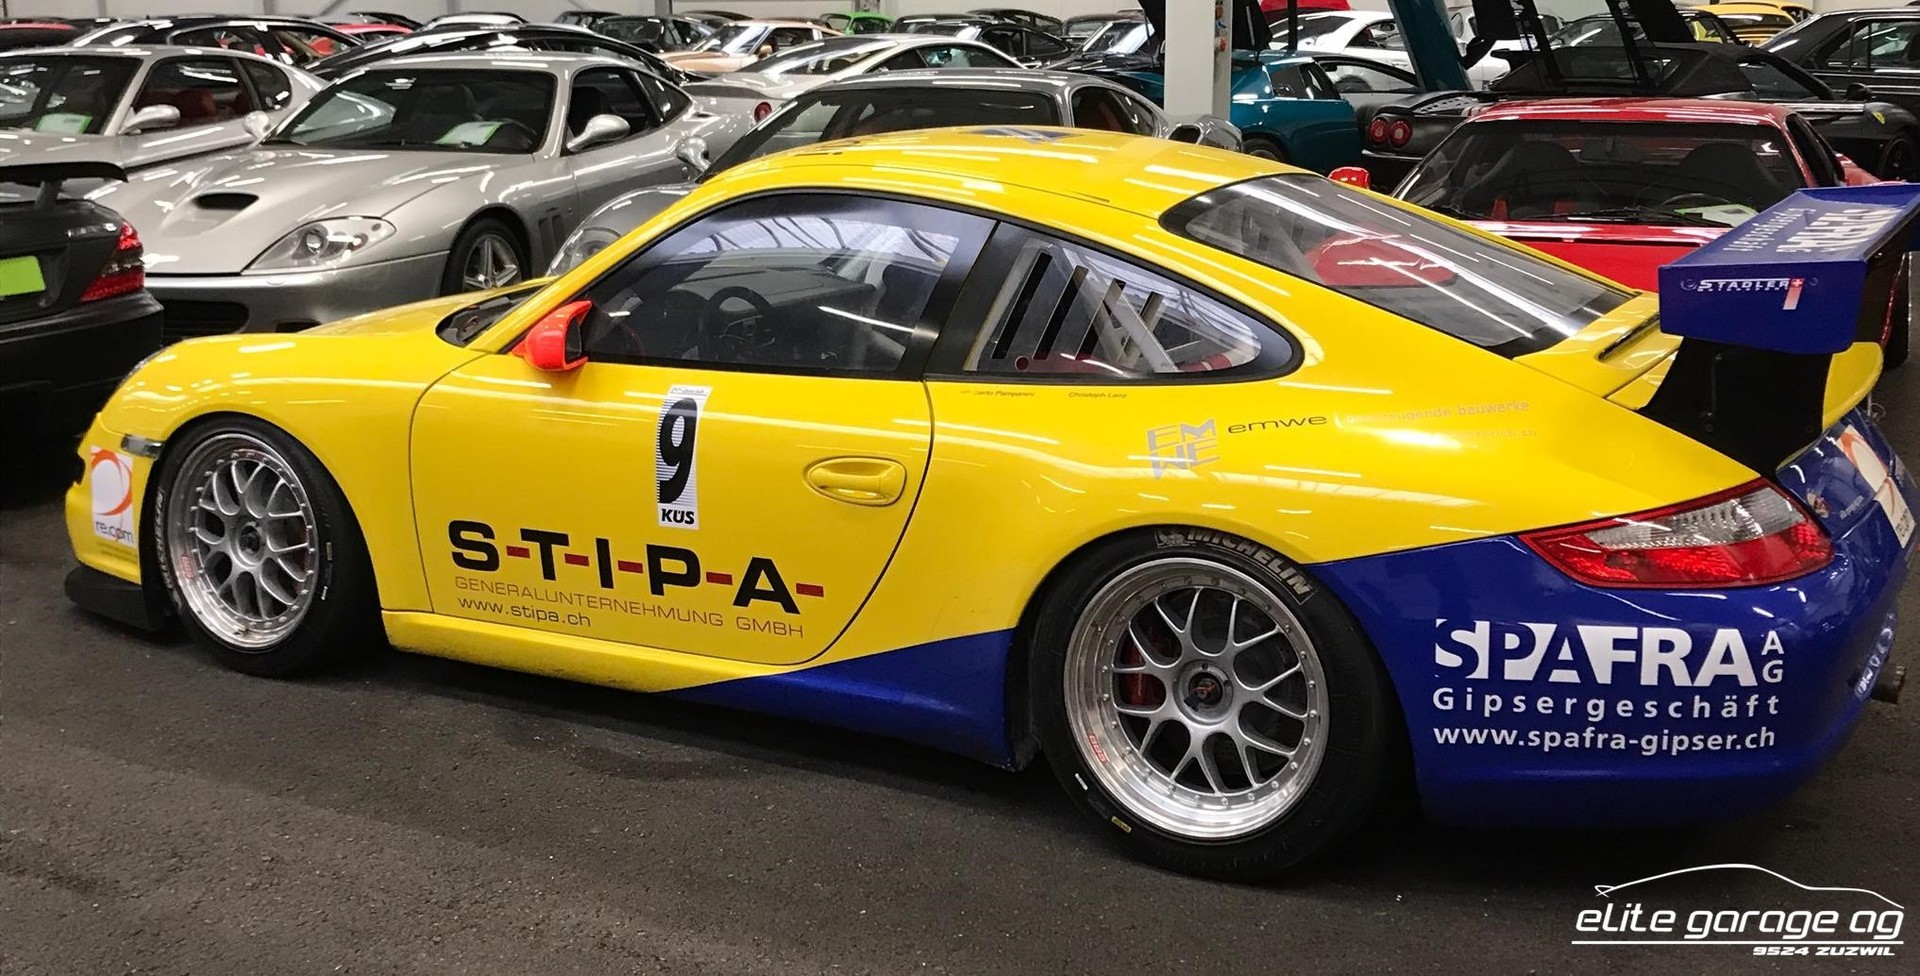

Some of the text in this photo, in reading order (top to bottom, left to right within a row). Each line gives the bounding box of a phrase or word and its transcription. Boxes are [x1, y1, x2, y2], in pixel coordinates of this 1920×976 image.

[1698, 277, 1790, 290] STADLER
[1067, 391, 1106, 400] Christoph
[1227, 415, 1328, 434] emwe
[658, 397, 698, 504] 9
[661, 508, 695, 525] KÜS
[1187, 527, 1311, 595] MICHELIN
[455, 576, 804, 638] GENERALUNTERNEHMUNG GMBH
[457, 597, 591, 628] www.stipa.ch
[1434, 618, 1758, 687] SPAFRA
[1432, 687, 1780, 722] Gipsergeschäft
[1433, 726, 1776, 756] www.spafra-gipser.ch
